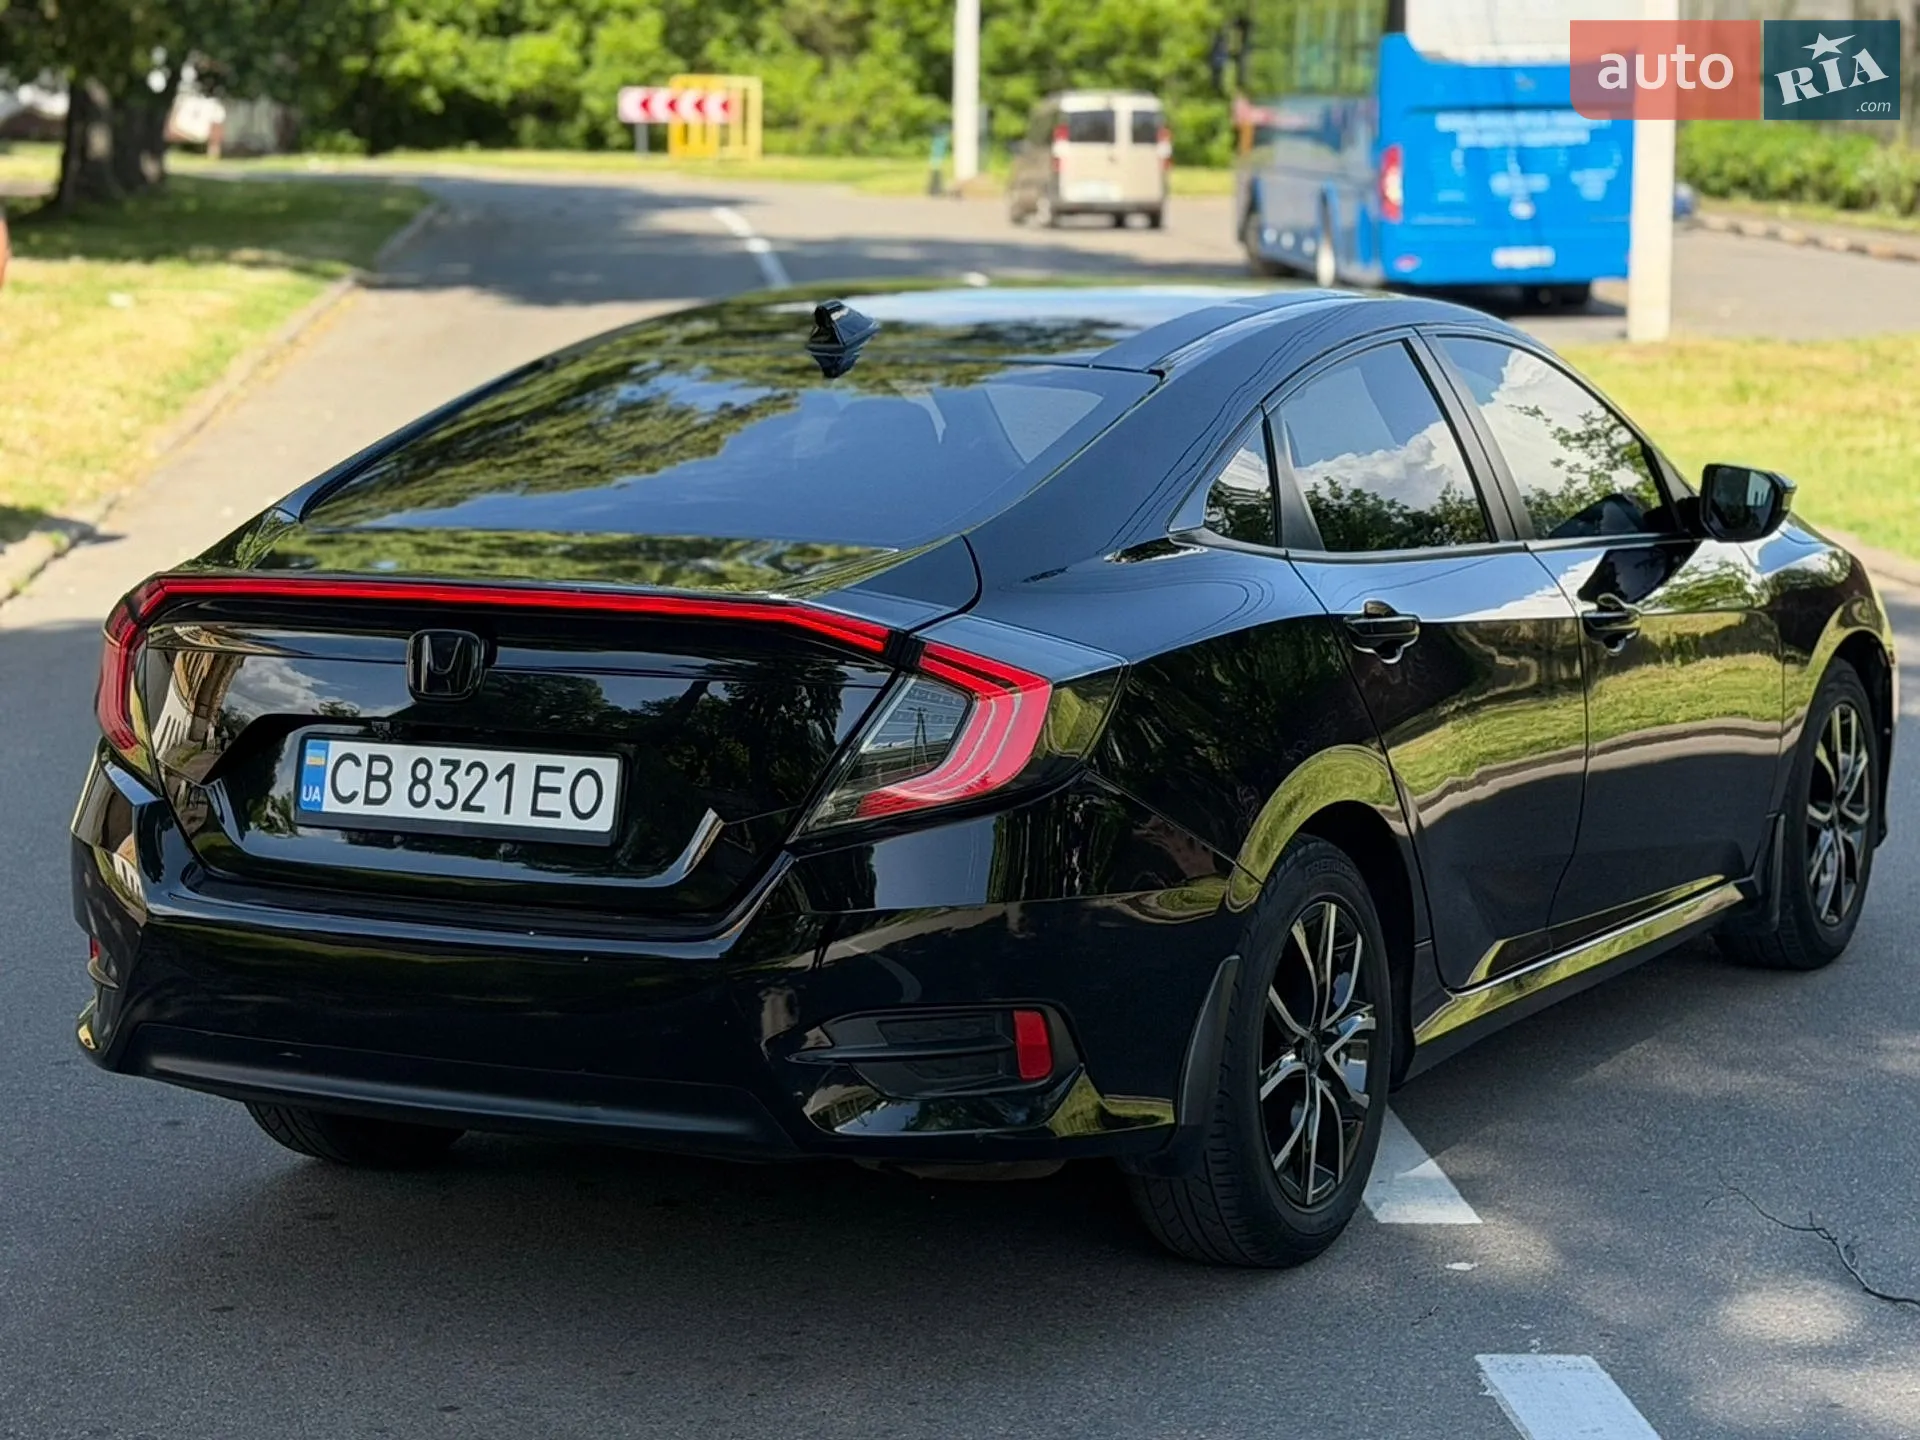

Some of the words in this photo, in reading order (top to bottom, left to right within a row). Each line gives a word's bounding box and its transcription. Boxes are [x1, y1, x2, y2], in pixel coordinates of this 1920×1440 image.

[302, 785, 322, 803] UA
[330, 752, 394, 806] CB
[407, 757, 516, 815] 8321
[530, 765, 604, 821] EO
